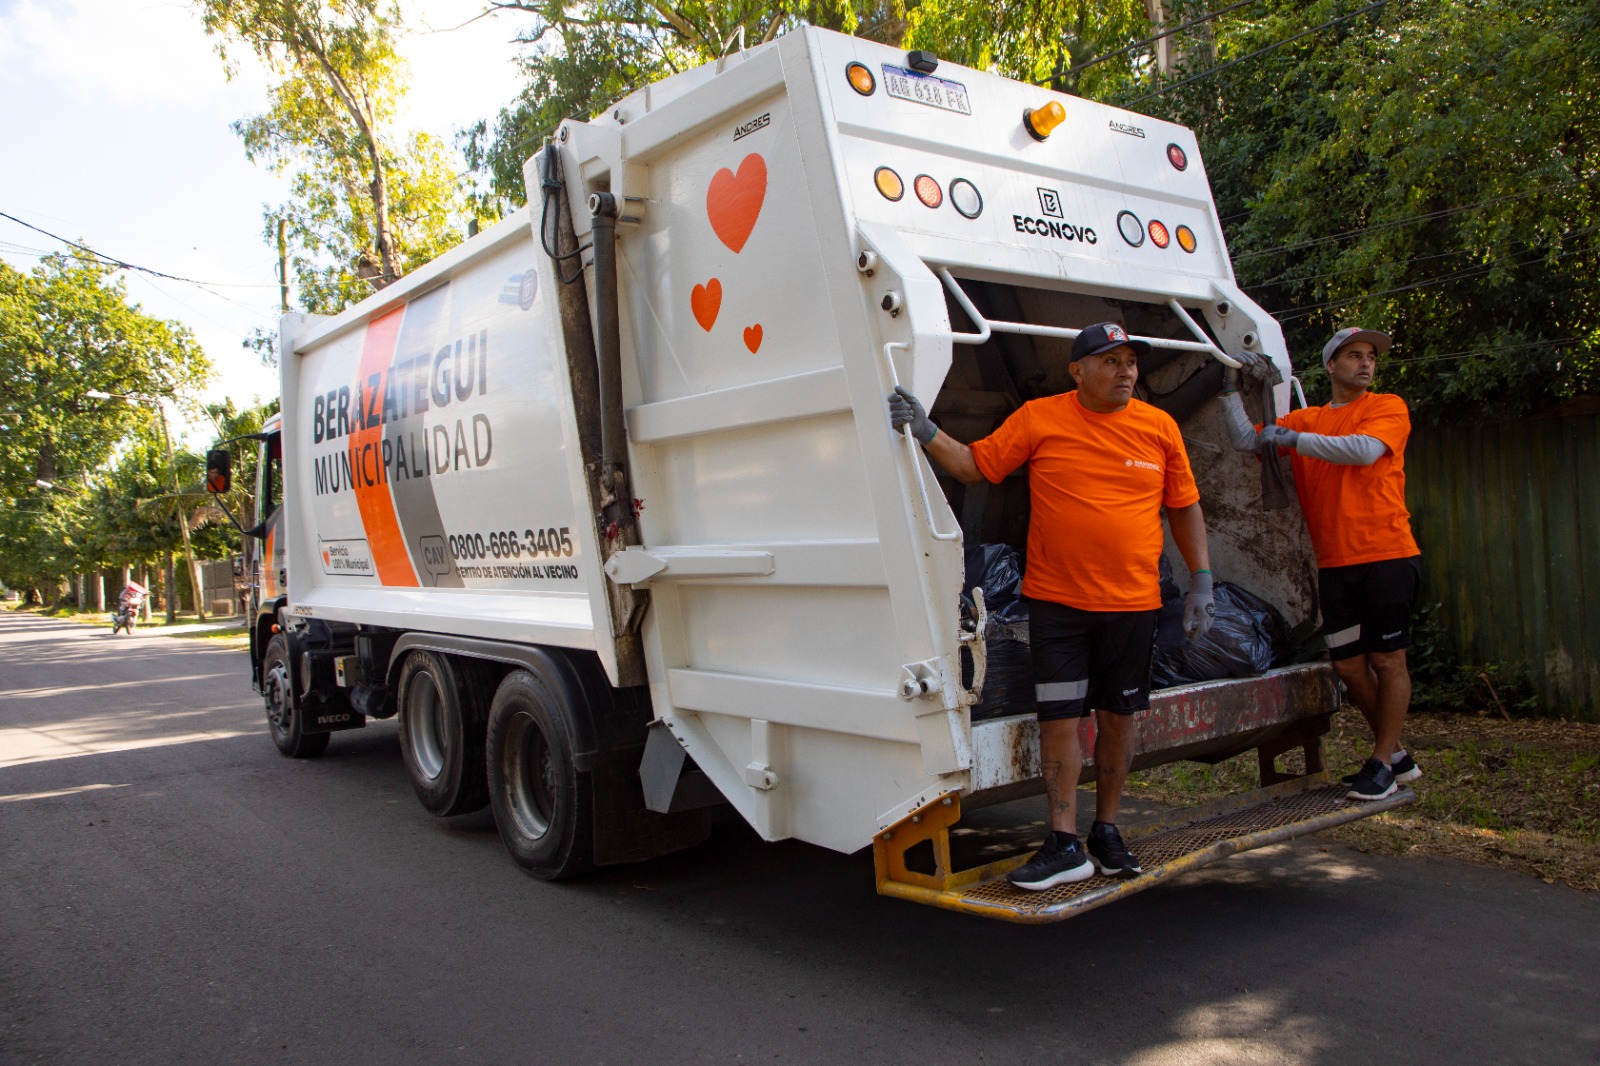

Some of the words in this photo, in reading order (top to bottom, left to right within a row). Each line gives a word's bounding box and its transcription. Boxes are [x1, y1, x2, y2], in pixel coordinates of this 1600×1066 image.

[733, 112, 770, 141] ANDRES
[1013, 214, 1098, 245] ECONOVO
[313, 328, 488, 445] BERAZATEGUI
[314, 413, 493, 497] MUNICIPALIDAD
[329, 545, 349, 557] Servicio
[449, 526, 574, 560] 0800-666-3405
[345, 559, 370, 572] Municipal
[424, 546, 445, 566] CAV
[456, 565, 481, 579] CENTRO
[482, 566, 493, 579] DE
[493, 562, 531, 579] ATENCIÓN
[532, 565, 545, 579] AL
[544, 564, 579, 580] VECINO
[317, 713, 351, 725] IVECO
